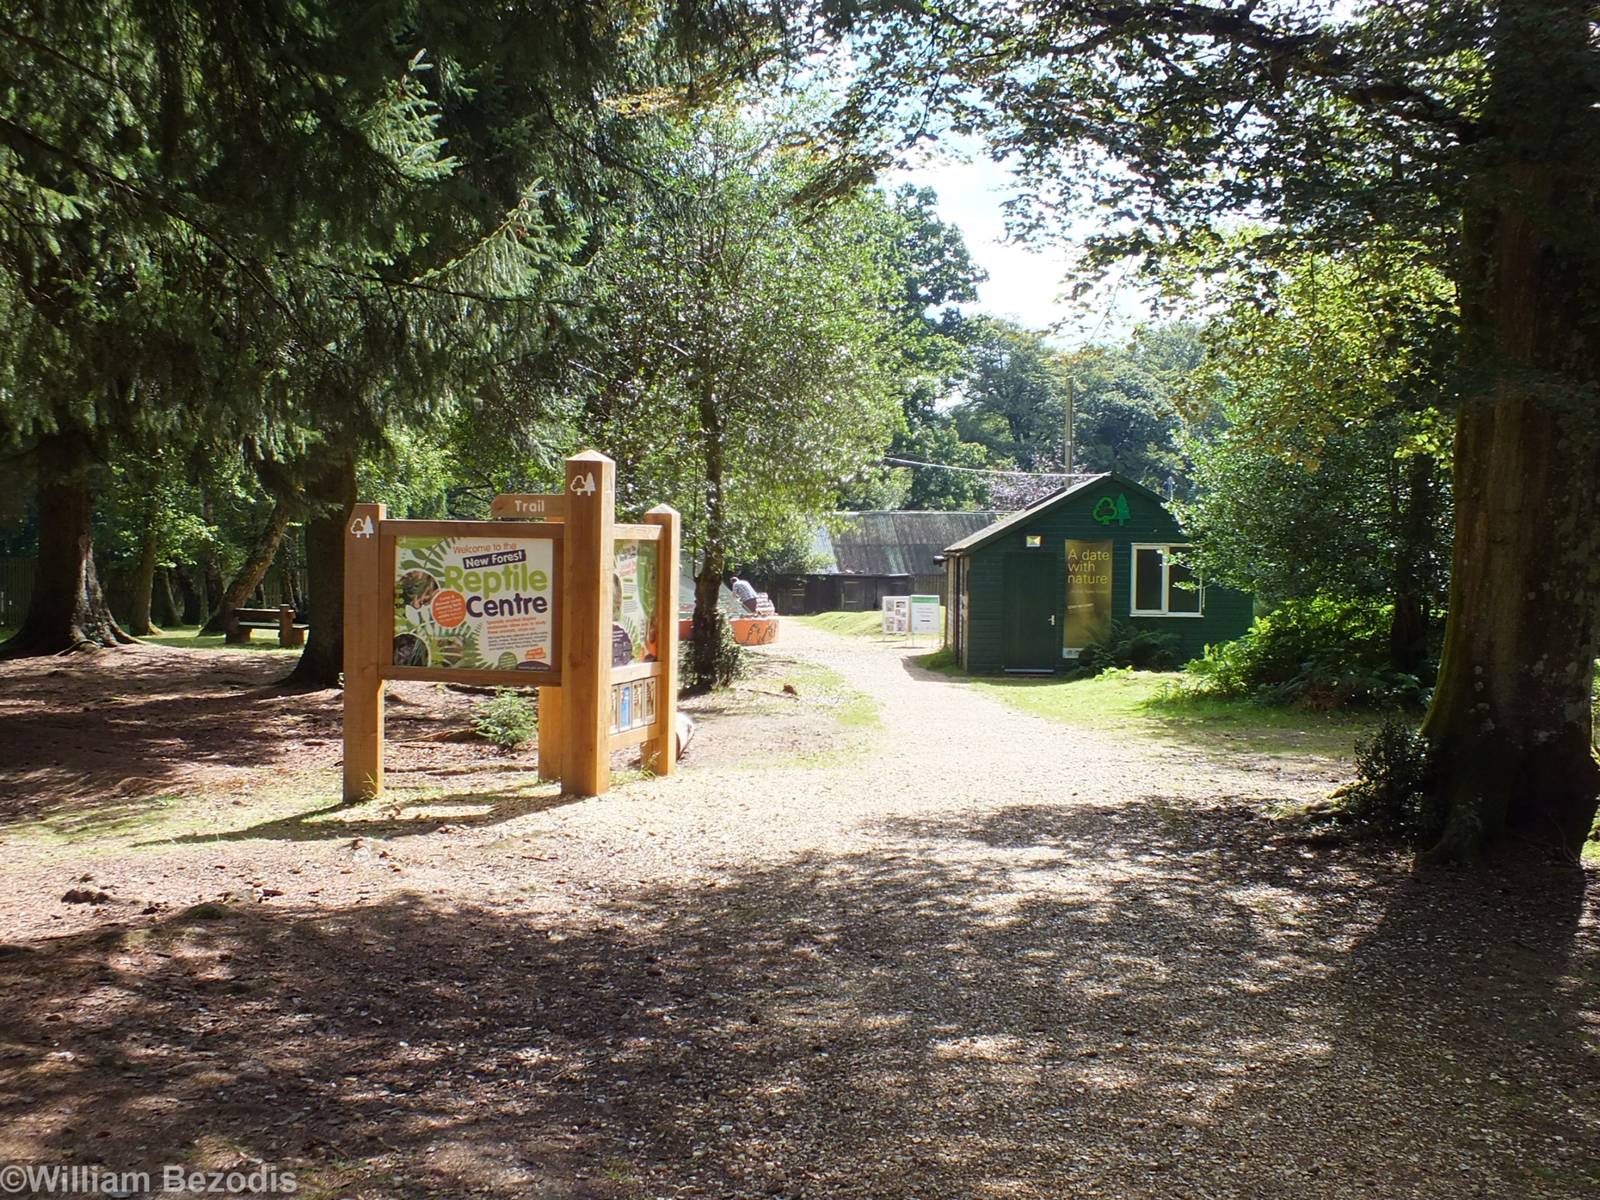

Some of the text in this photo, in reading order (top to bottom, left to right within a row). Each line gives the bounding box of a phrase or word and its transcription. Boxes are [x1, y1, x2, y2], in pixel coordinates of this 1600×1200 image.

[514, 499, 545, 512] Trail
[453, 542, 517, 554] Welcome to the
[465, 550, 523, 568] New Forest
[1068, 549, 1110, 561] A date
[1067, 560, 1096, 572] with
[445, 563, 548, 600] Reptile
[1067, 575, 1108, 584] nature
[466, 592, 548, 618] Centre
